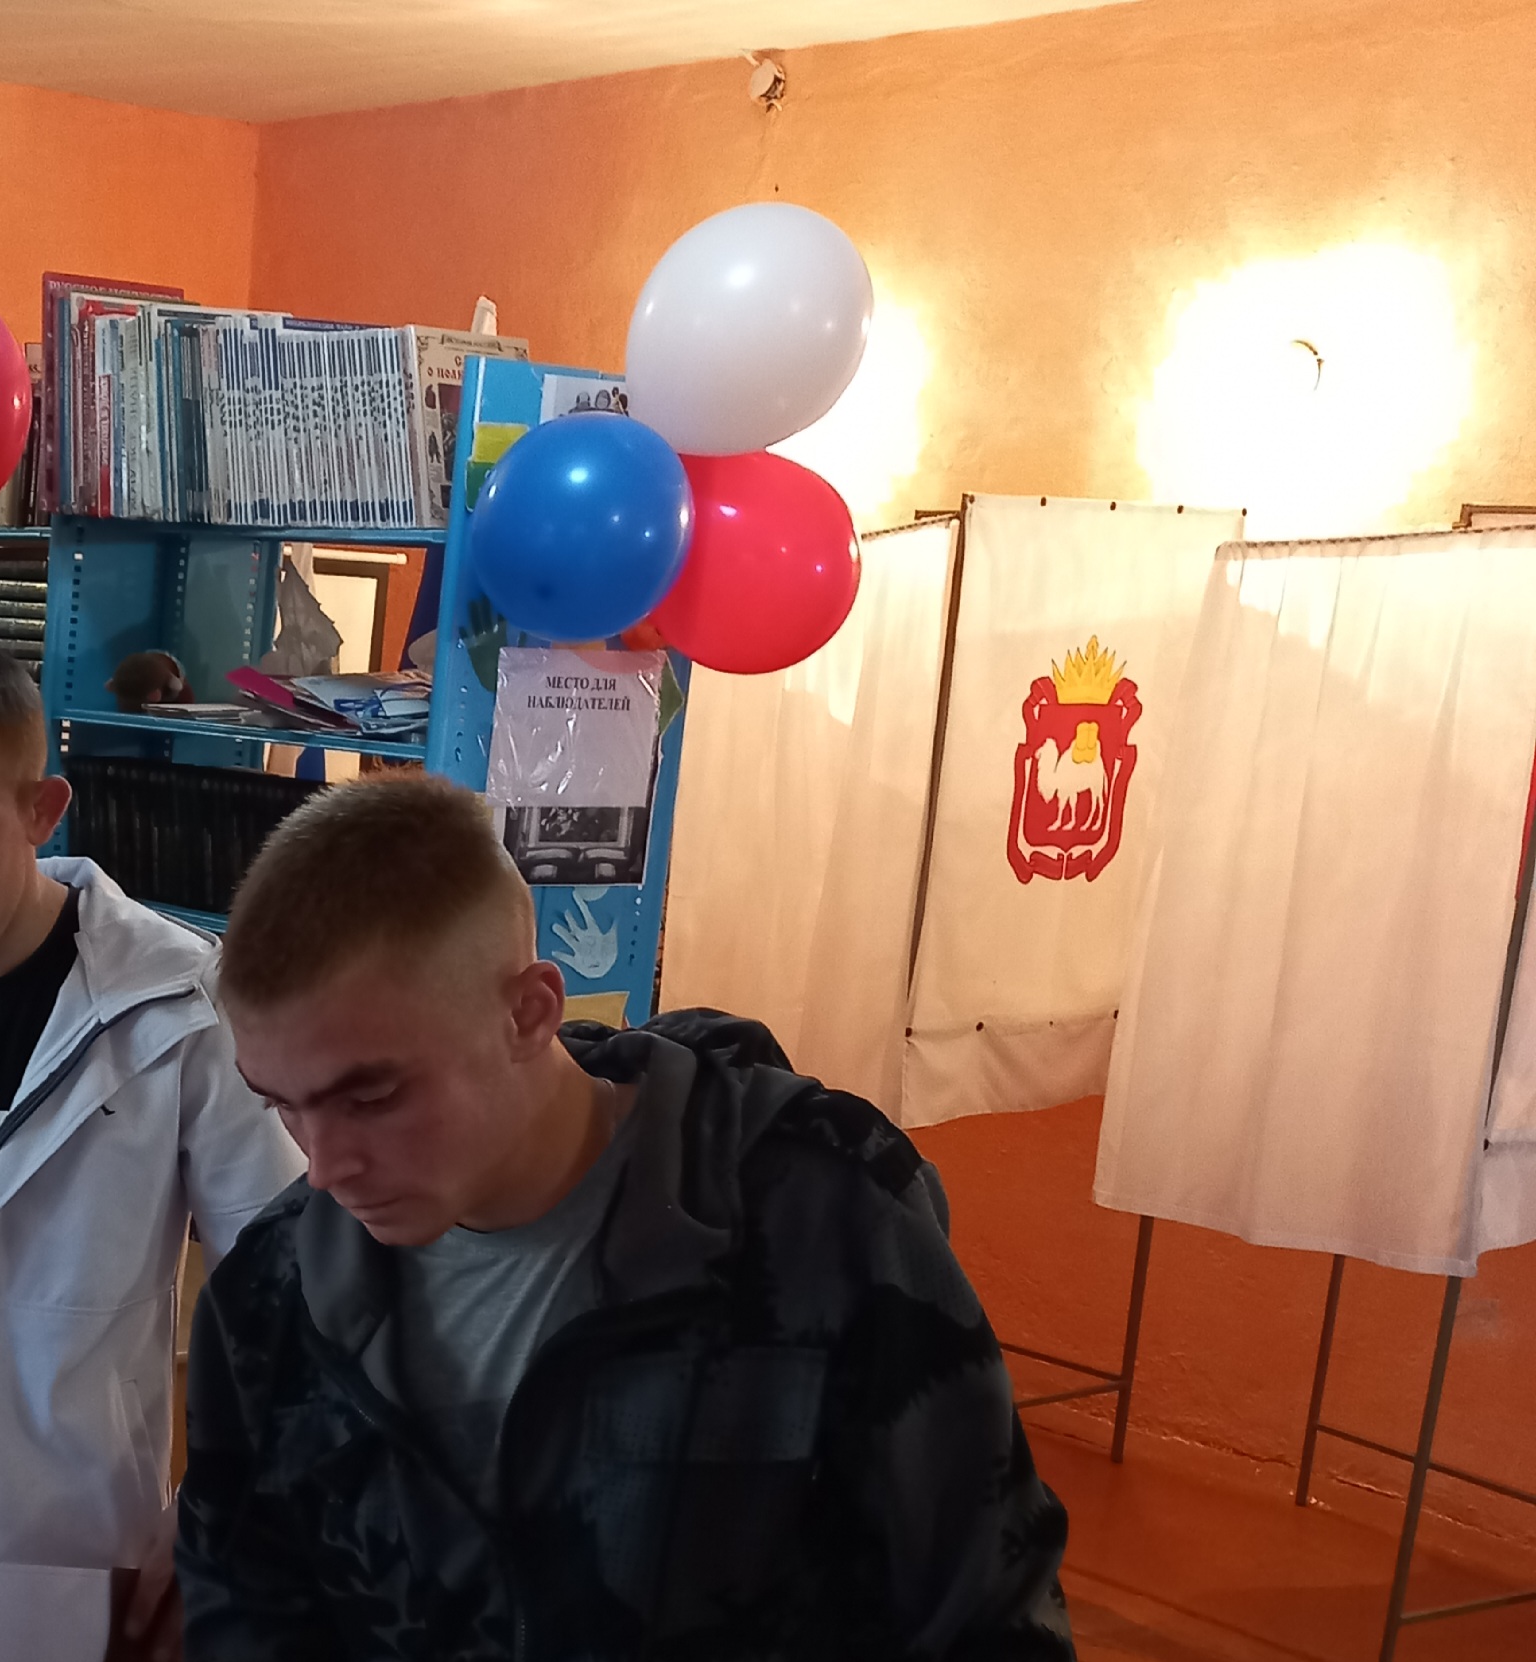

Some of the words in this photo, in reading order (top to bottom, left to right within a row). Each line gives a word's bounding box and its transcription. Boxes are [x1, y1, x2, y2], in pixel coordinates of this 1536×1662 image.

[546, 675, 589, 690] МЕСТО
[591, 678, 617, 692] ДЛЯ
[527, 695, 631, 712] НАБЛЮДАТЕЛЕЙ
